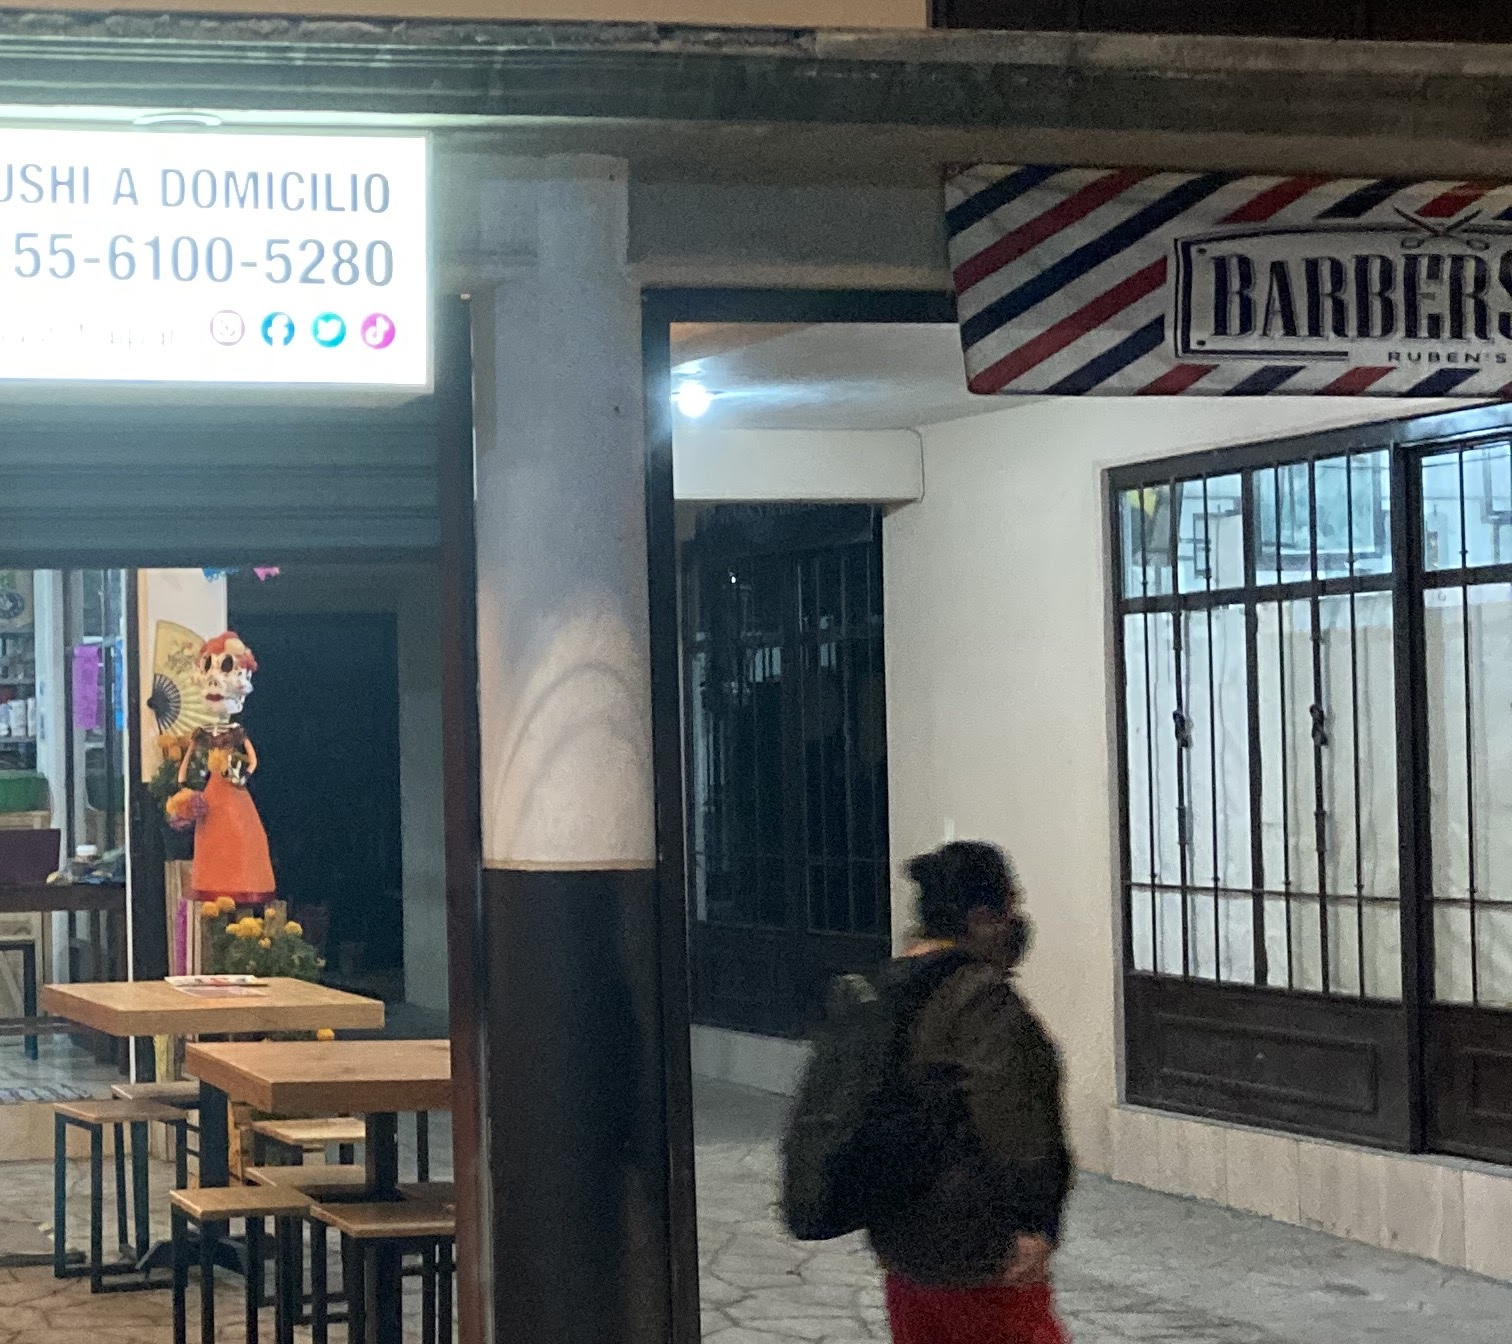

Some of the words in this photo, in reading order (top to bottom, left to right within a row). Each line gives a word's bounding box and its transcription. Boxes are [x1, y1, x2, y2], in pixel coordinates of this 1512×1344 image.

[112, 165, 140, 207] A
[160, 167, 391, 214] DOMICILIO
[13, 231, 396, 288] 55-6100-5280
